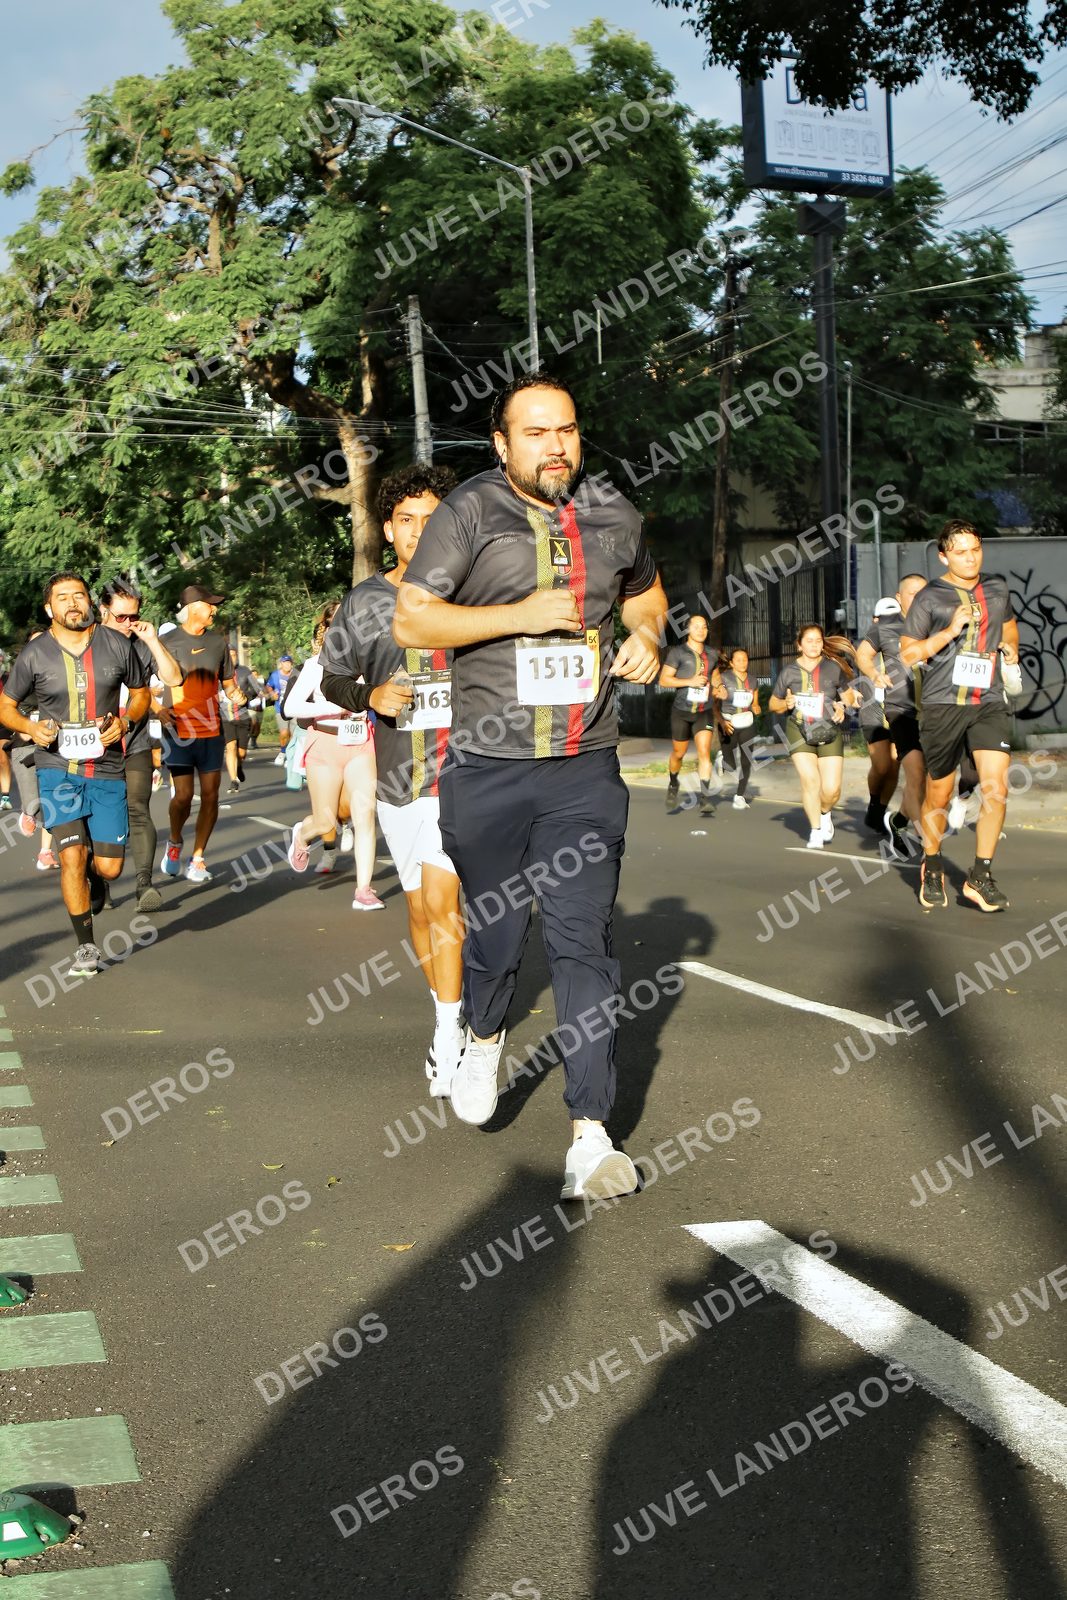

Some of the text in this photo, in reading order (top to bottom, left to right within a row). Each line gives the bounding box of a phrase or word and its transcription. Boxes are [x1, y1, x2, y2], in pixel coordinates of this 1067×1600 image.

[529, 655, 584, 679] 1513
[961, 662, 987, 675] 9181
[64, 733, 96, 747] 9169
